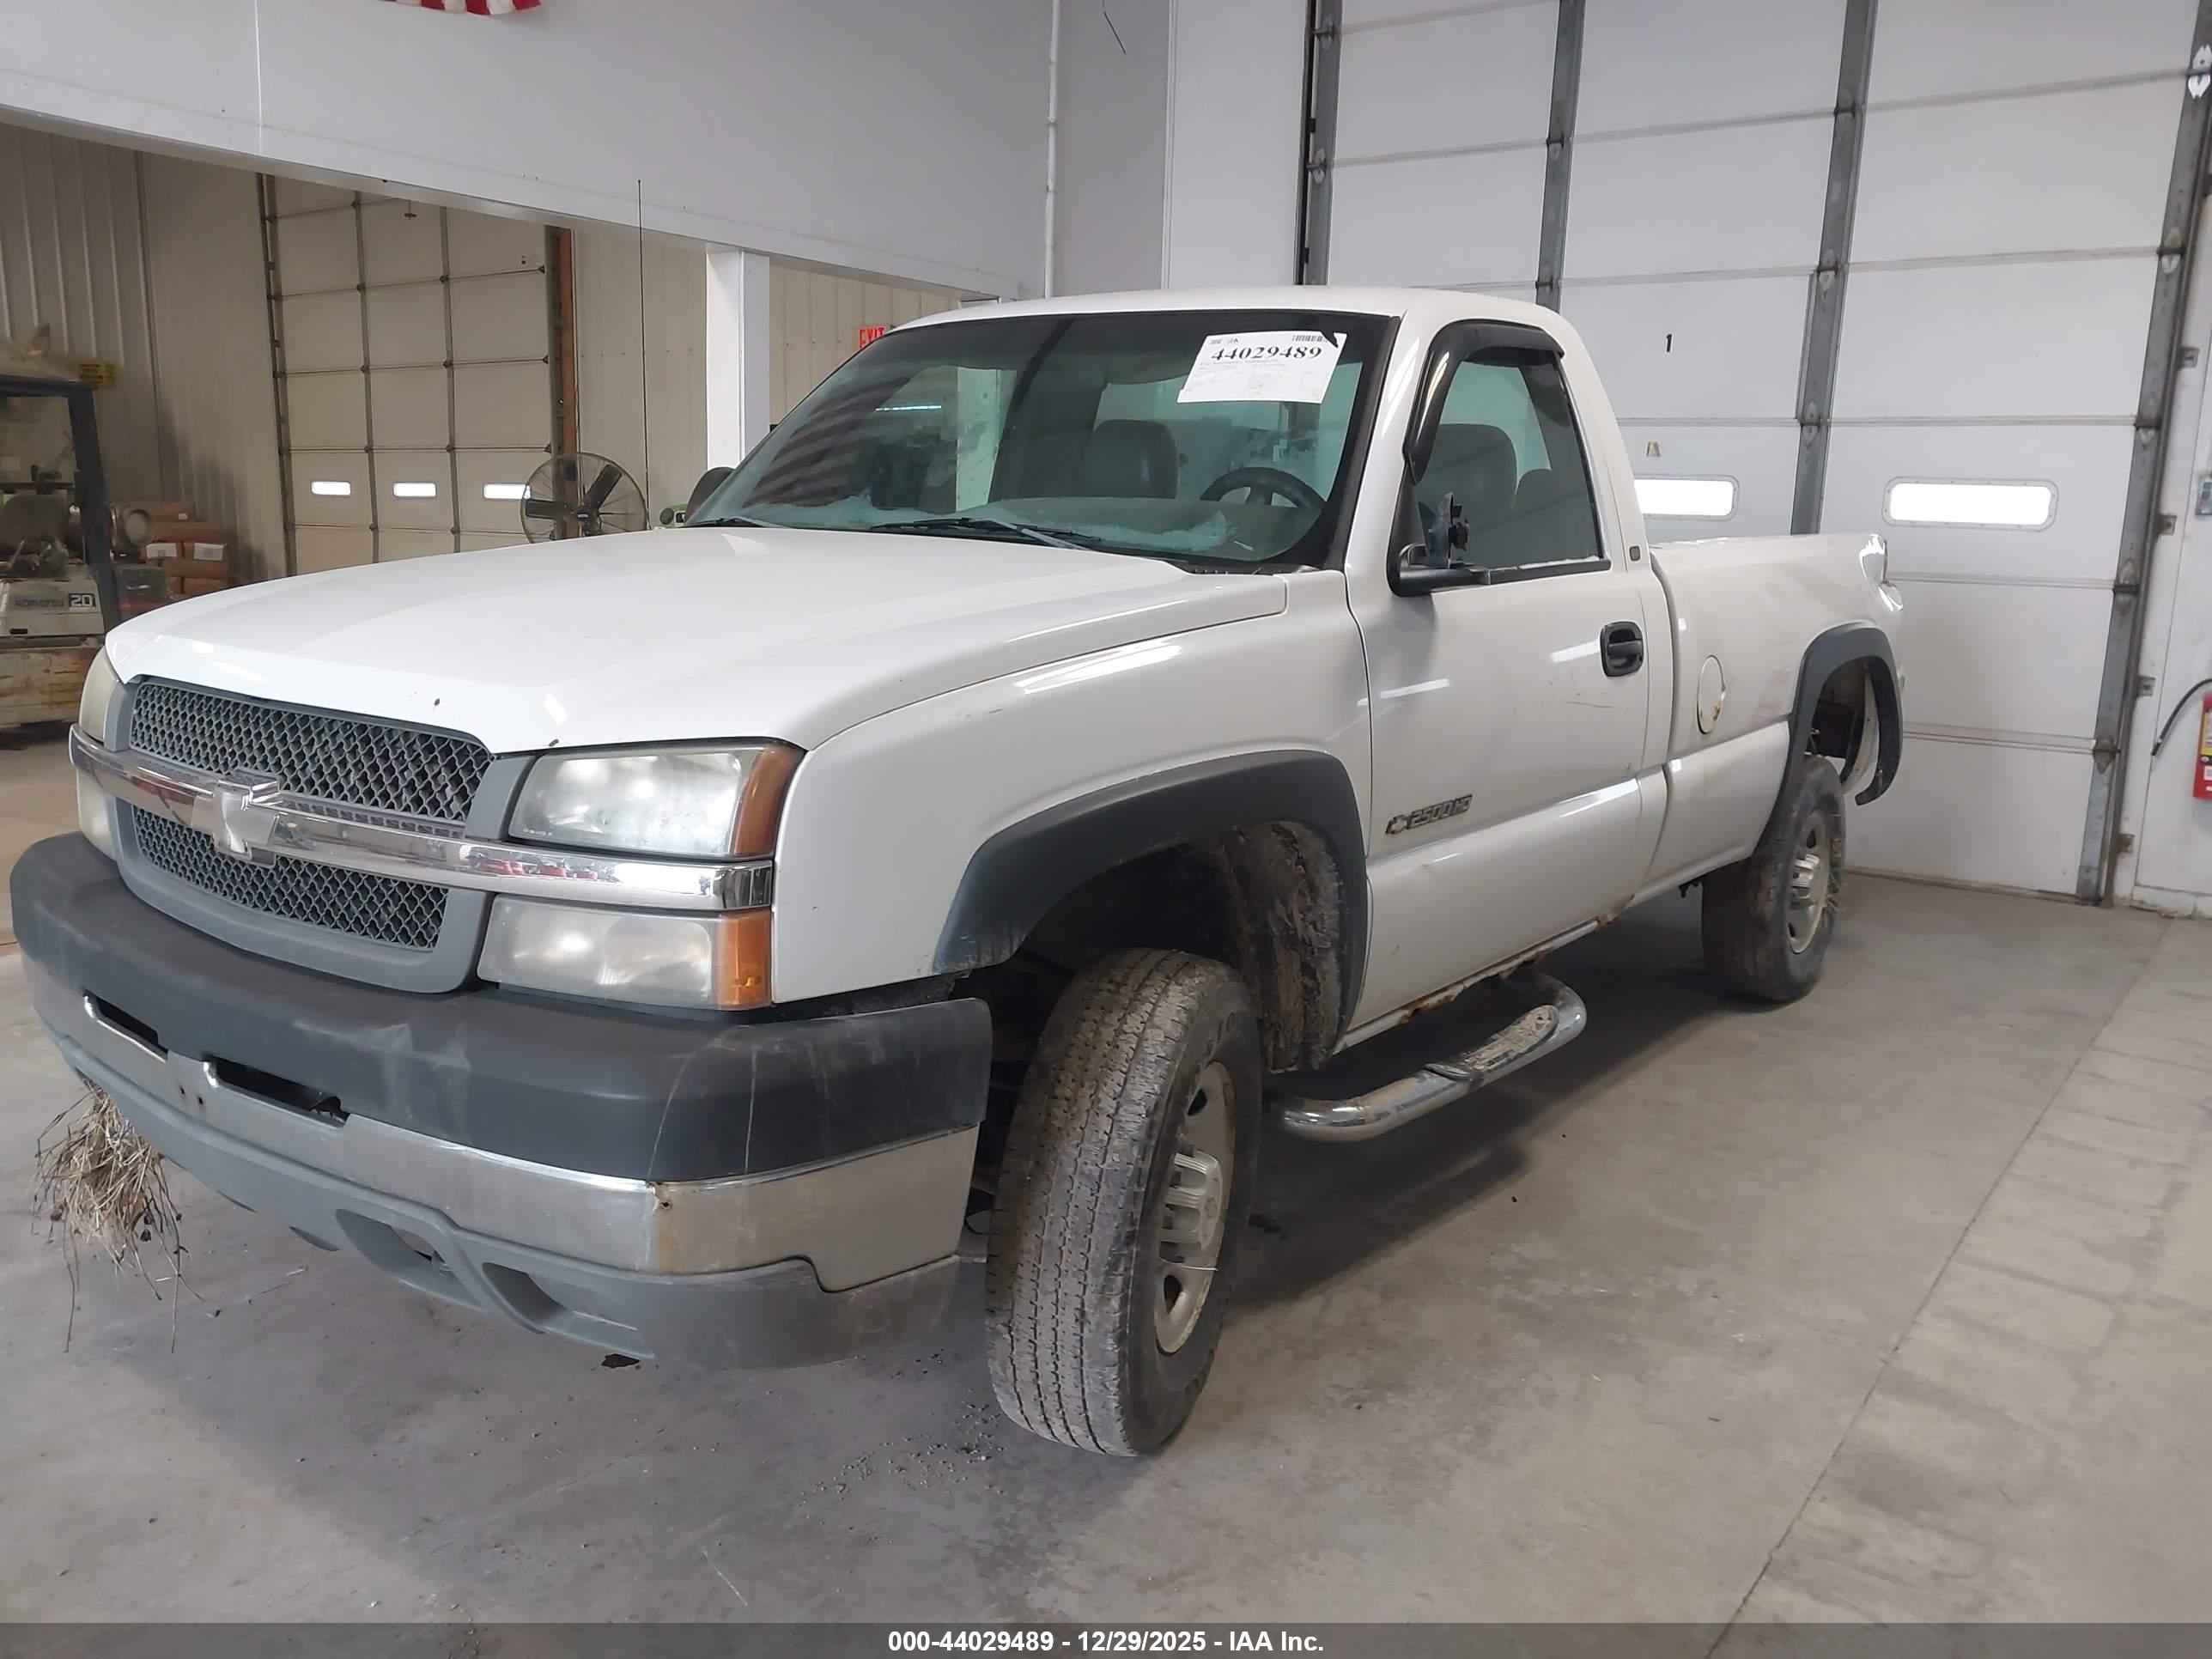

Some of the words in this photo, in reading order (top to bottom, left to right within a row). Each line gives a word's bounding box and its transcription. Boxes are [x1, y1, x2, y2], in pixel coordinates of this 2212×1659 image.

[860, 327, 884, 349] EXIT
[1666, 333, 1673, 353] 1
[1211, 345, 1322, 361] 44029489
[70, 594, 93, 607] 20
[1408, 794, 1473, 830] 2500HD
